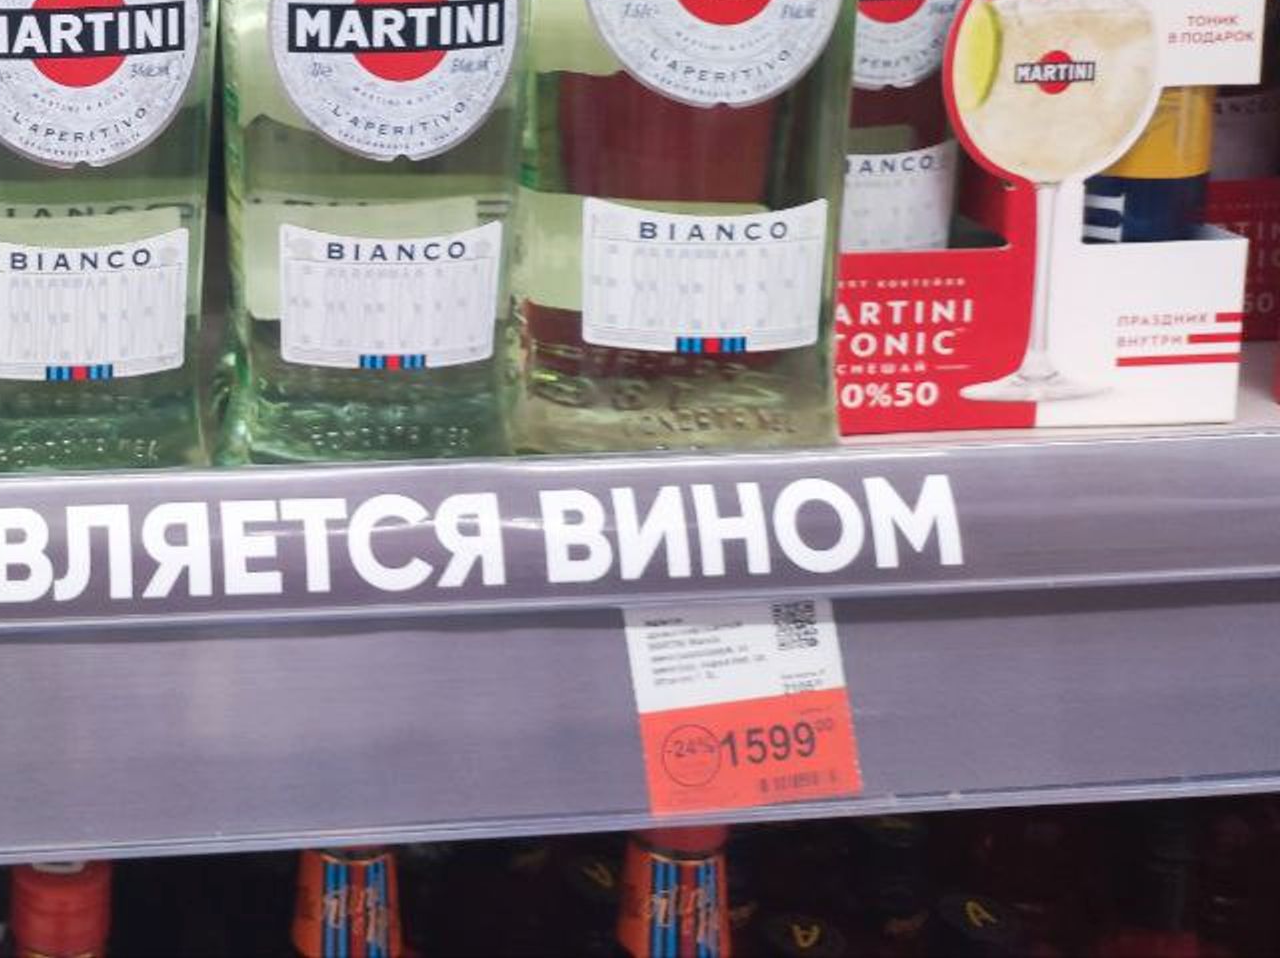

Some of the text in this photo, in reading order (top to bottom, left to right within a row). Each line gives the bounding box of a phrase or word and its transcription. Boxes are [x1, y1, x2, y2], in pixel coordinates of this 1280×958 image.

[295, 2, 499, 49] MARTINI
[1187, 15, 1240, 27] ТОНИК
[1181, 31, 1255, 44] ПОДАРОК
[1017, 63, 1094, 83] MARTINI
[639, 220, 788, 242] BIANCO
[10, 248, 153, 272] BIANCO
[326, 241, 467, 262] BIANCO
[835, 299, 973, 326] ARTINI
[1118, 313, 1209, 327] ПРАЗДНИК
[1116, 334, 1184, 348] ВНУТРИ
[840, 381, 940, 409] 0%50
[539, 474, 964, 585] ВИНОМ
[720, 722, 817, 768] 1599
